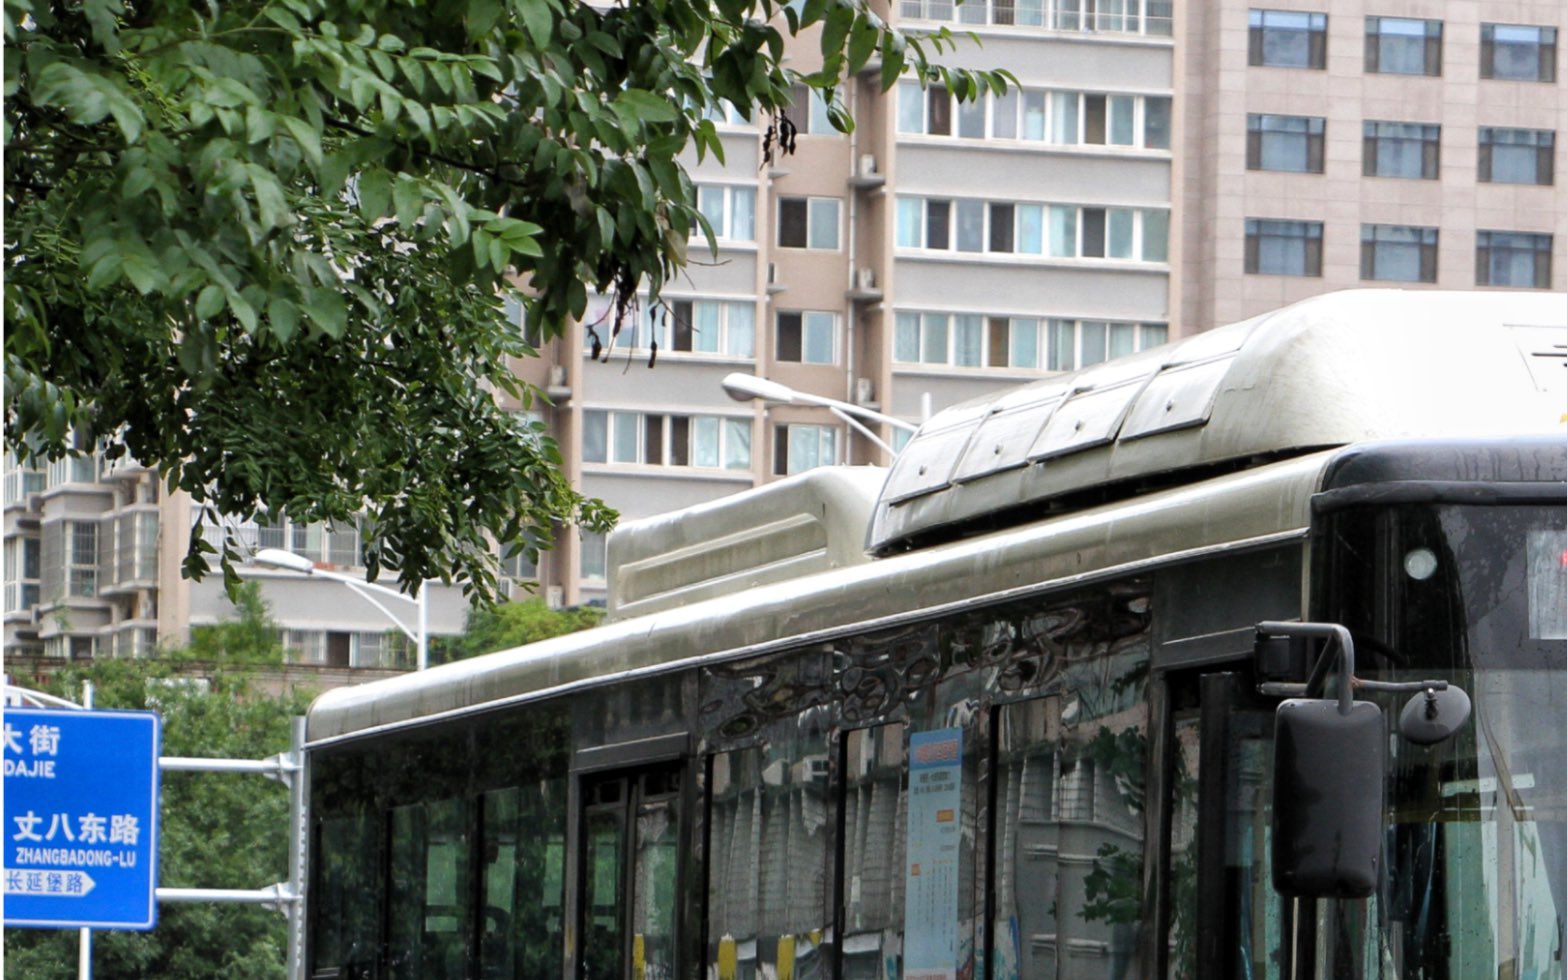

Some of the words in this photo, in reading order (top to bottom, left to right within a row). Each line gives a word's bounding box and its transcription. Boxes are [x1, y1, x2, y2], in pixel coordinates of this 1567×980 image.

[13, 810, 141, 846] 丈八东路
[16, 847, 136, 867] ZHANGBADONG-LU
[6, 870, 84, 894] 长延堡路
